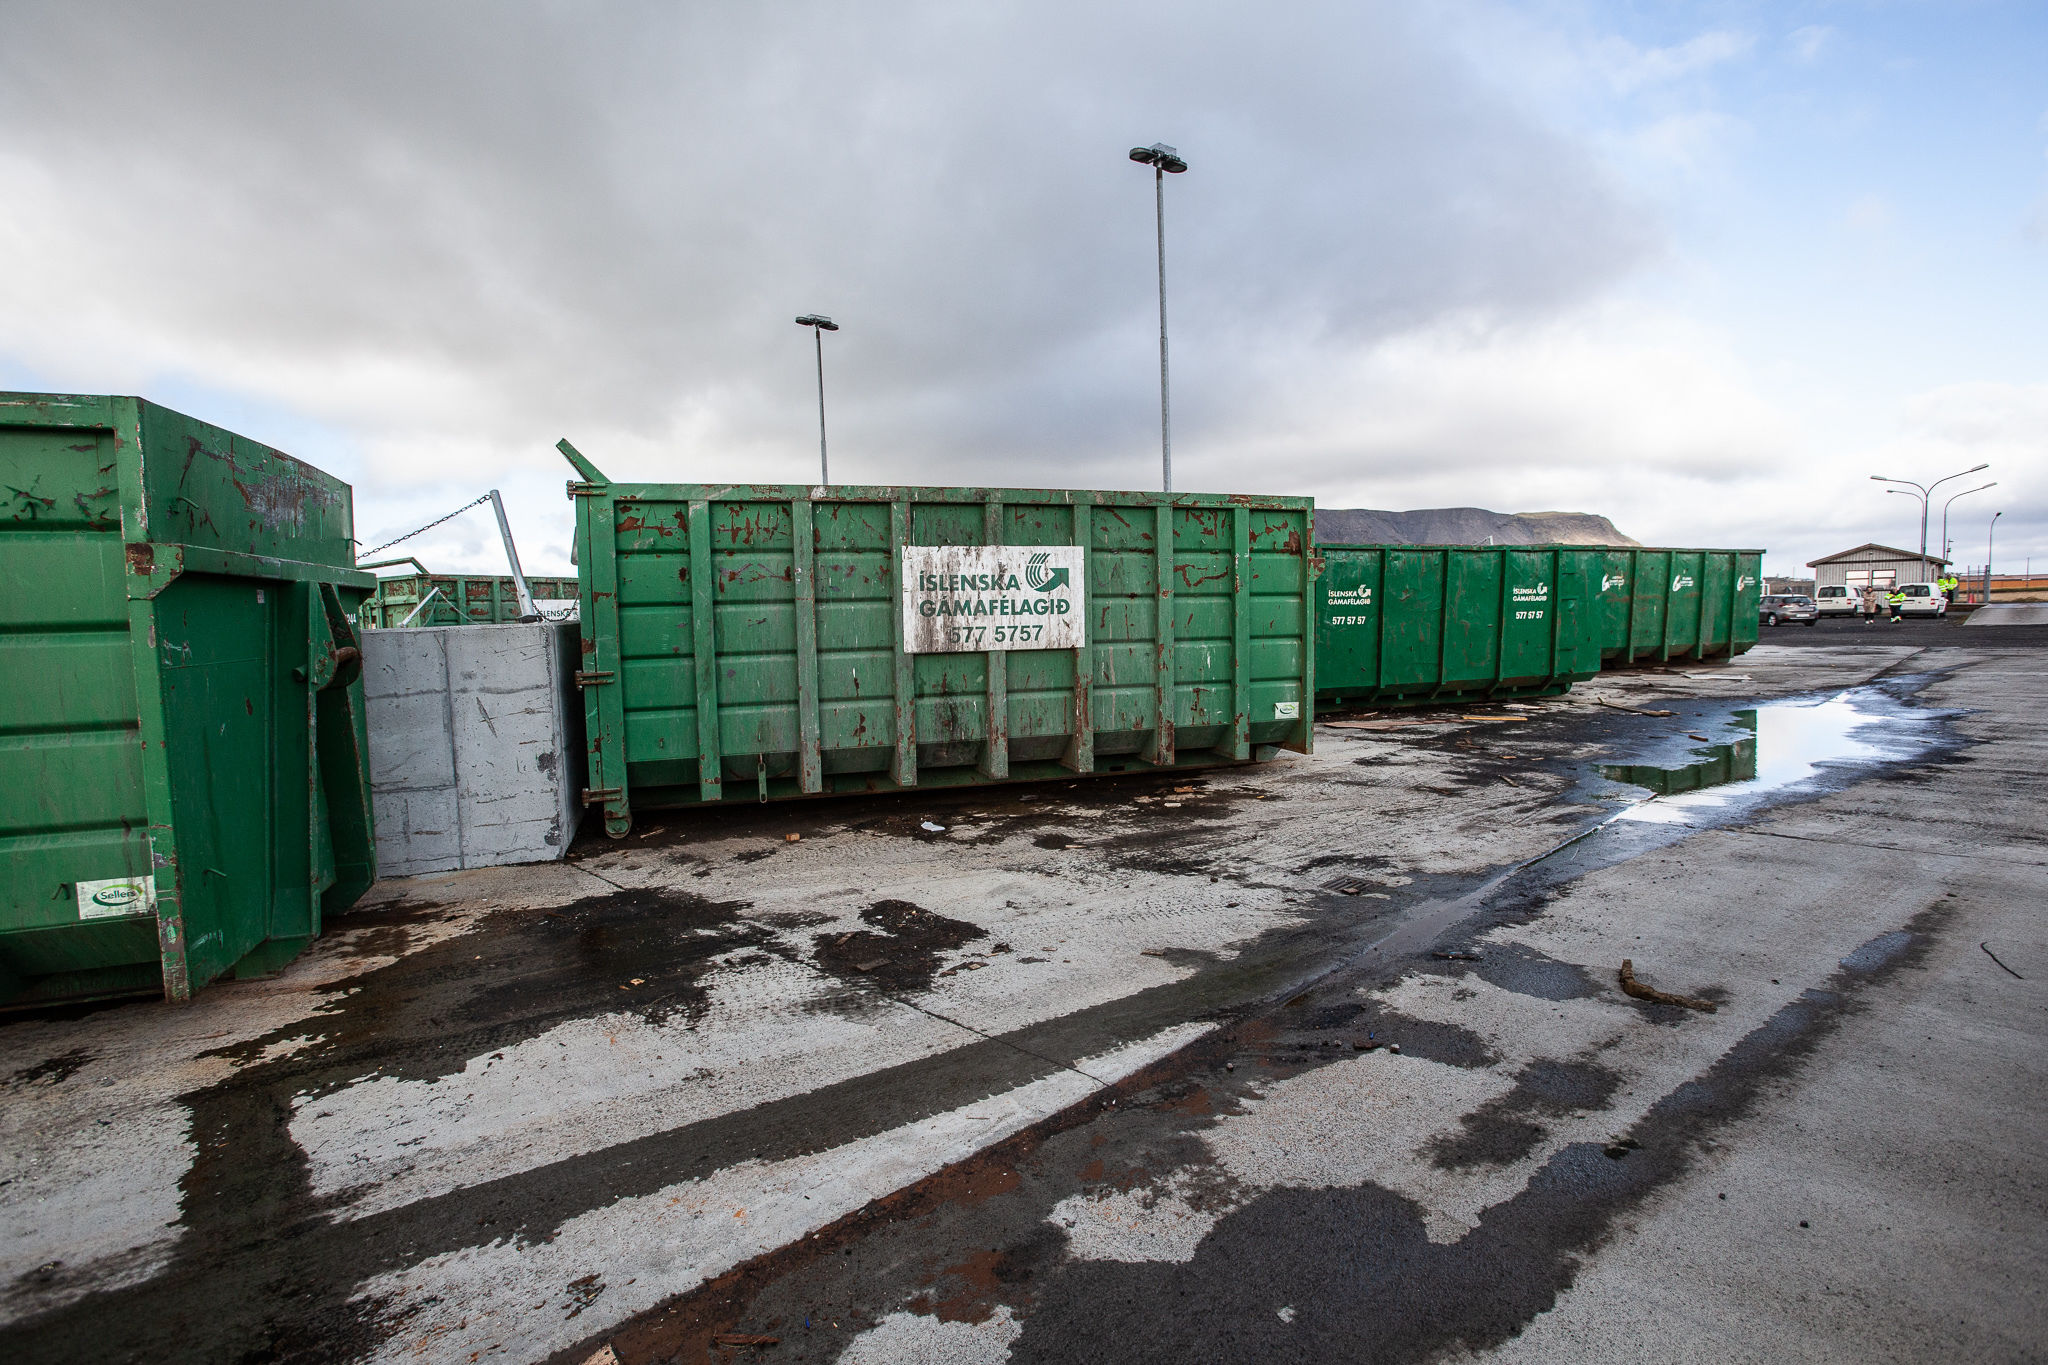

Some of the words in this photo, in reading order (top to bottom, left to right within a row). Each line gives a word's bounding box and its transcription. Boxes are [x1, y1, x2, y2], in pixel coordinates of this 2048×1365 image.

[919, 571, 1020, 591] ÍSLENSKA
[1328, 589, 1358, 598] ÍSLENSKA
[919, 595, 1070, 617] GÁMAFÉLAGIÐ
[1332, 616, 1346, 625] 577
[1346, 616, 1356, 625] 57
[1357, 616, 1366, 625] 57
[1515, 611, 1527, 620] 577
[1527, 611, 1536, 619] 57
[1536, 611, 1544, 619] 57
[950, 627, 986, 643] 577
[995, 625, 1043, 643] 5757
[101, 890, 137, 900] Sellers
